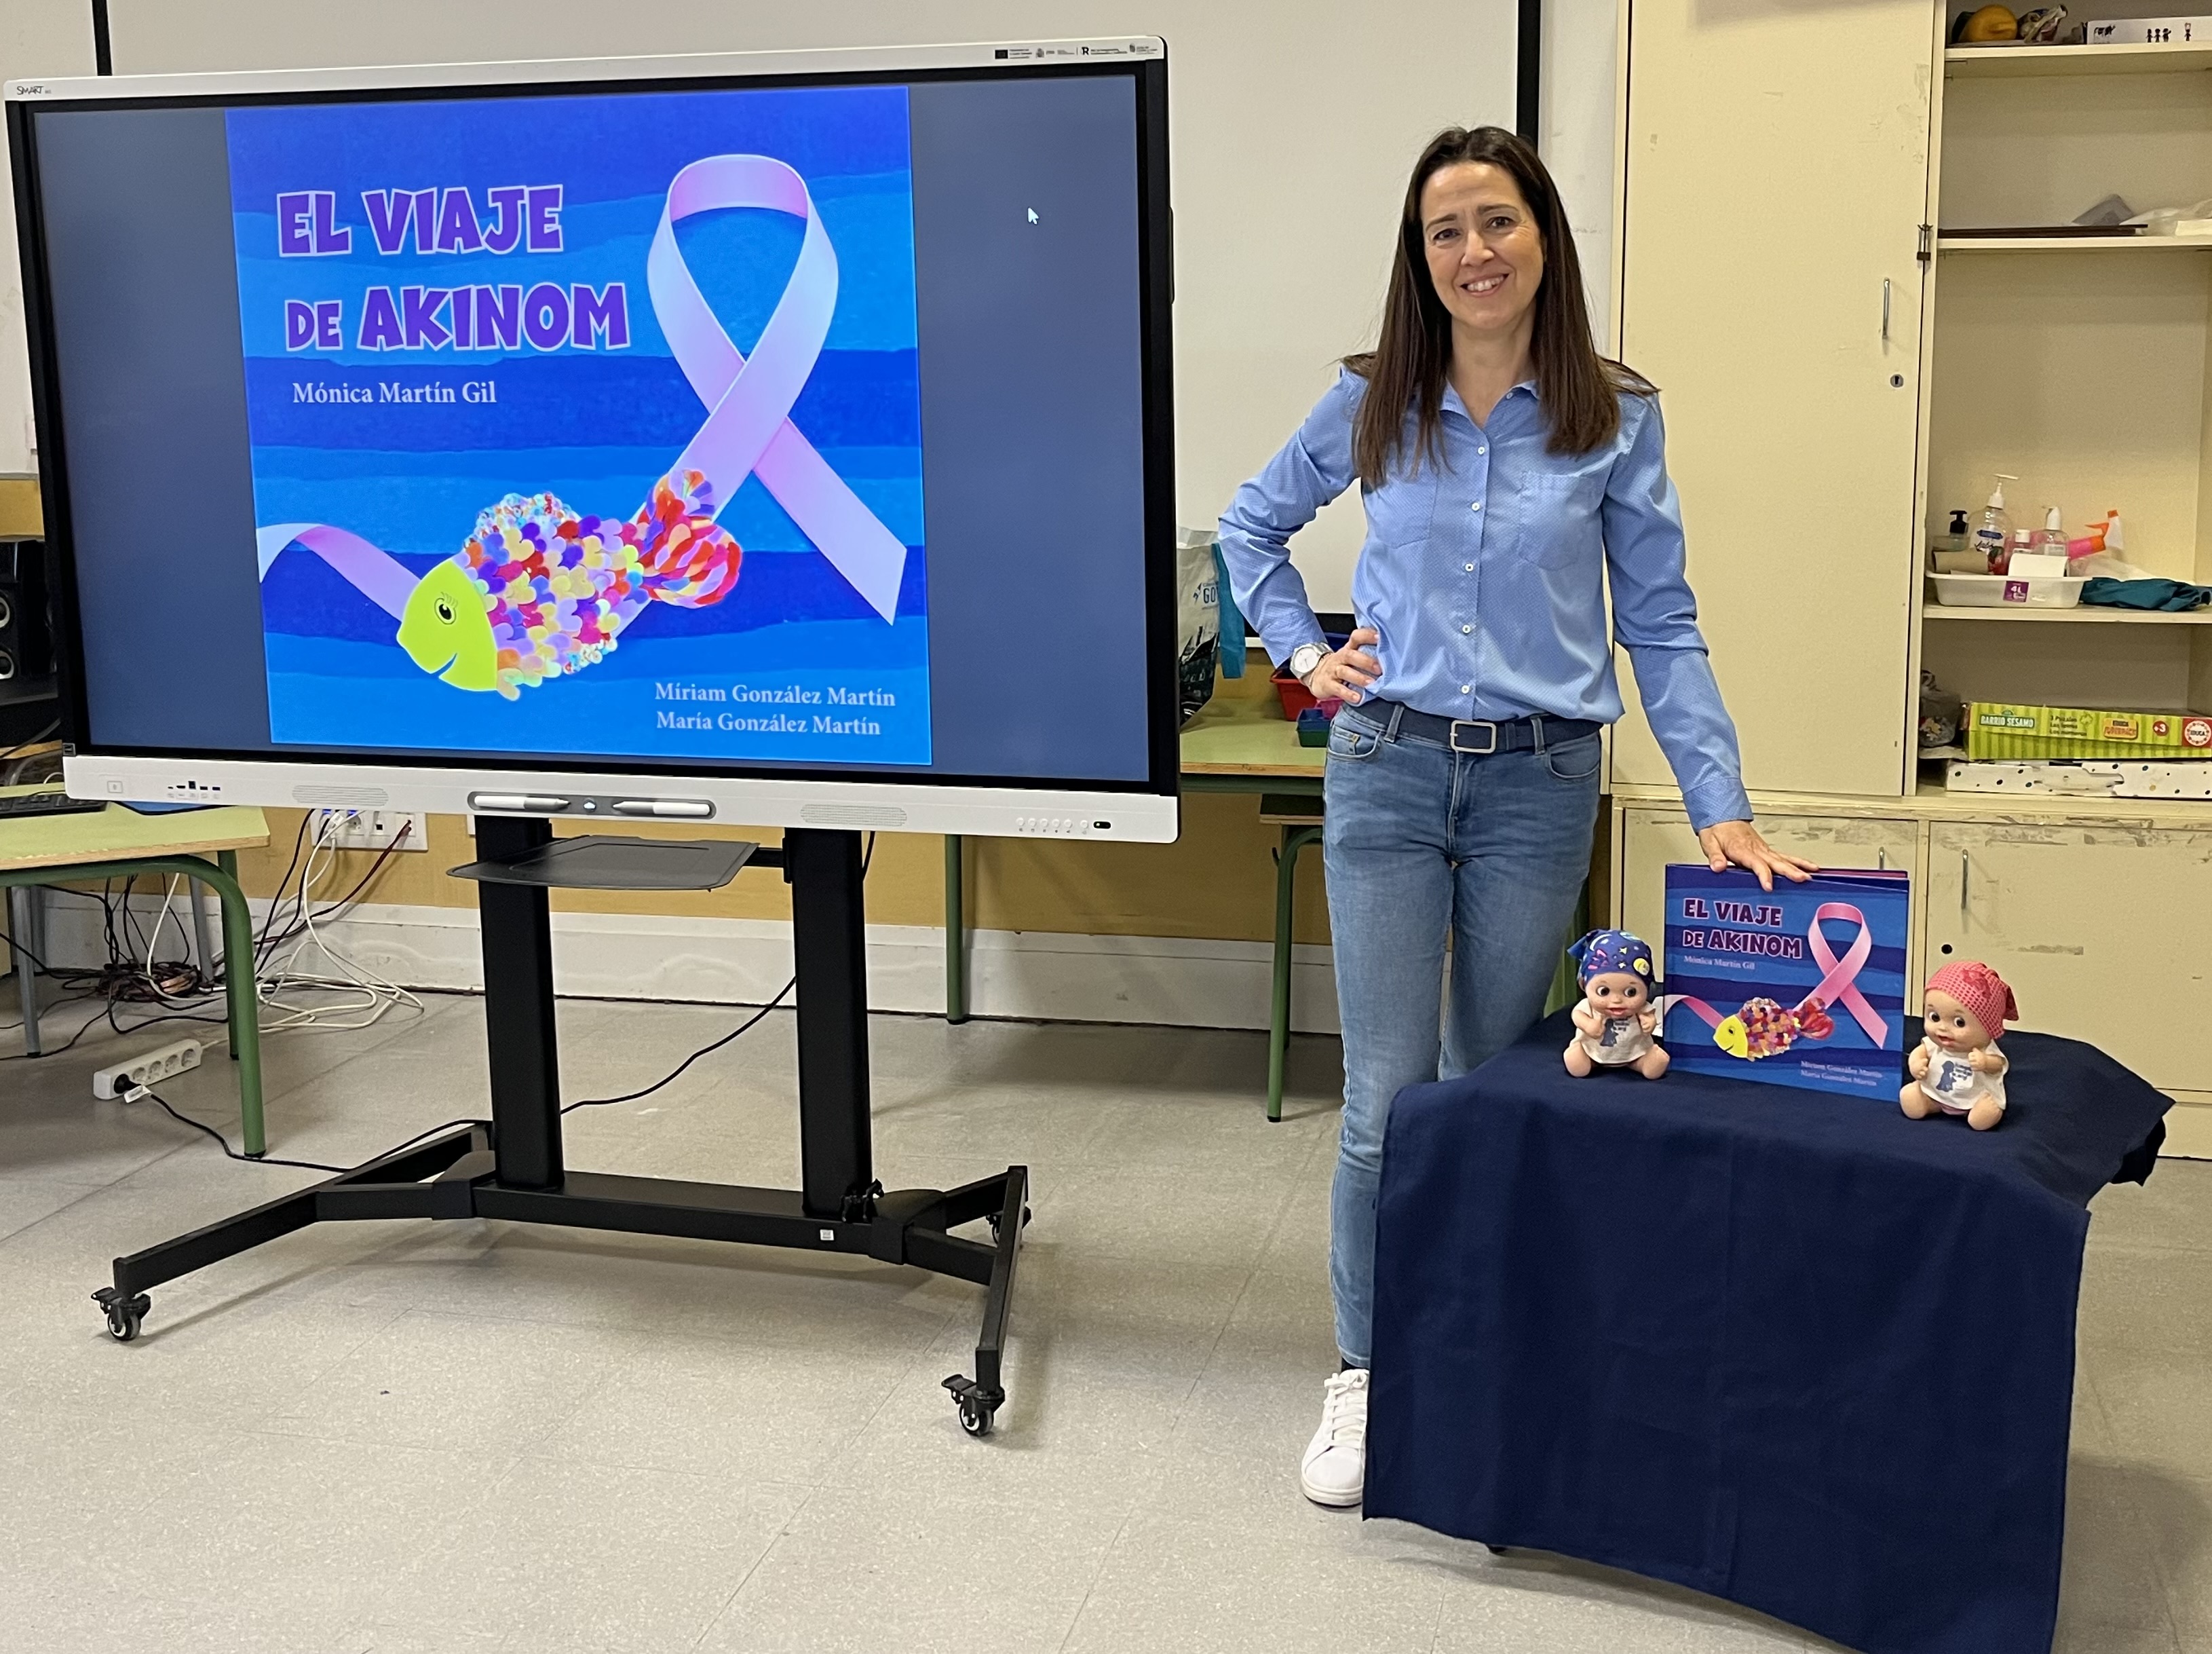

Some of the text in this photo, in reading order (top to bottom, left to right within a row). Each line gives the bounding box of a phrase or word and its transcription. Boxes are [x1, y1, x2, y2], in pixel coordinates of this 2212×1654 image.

[16, 86, 44, 95] SMART
[277, 184, 564, 257] EL VIAJE
[285, 282, 631, 352] DE AKINOM
[292, 380, 496, 405] Mónica Martín Gil
[655, 681, 896, 707] Míriam González Martín
[656, 710, 881, 735] María González Martín
[1981, 715, 2034, 728] BARRIO SESAMO
[1683, 898, 1783, 927] EL VIAJE
[1683, 930, 1802, 960] DE AKINOM
[1683, 955, 1755, 969] Mónica Martín Gil
